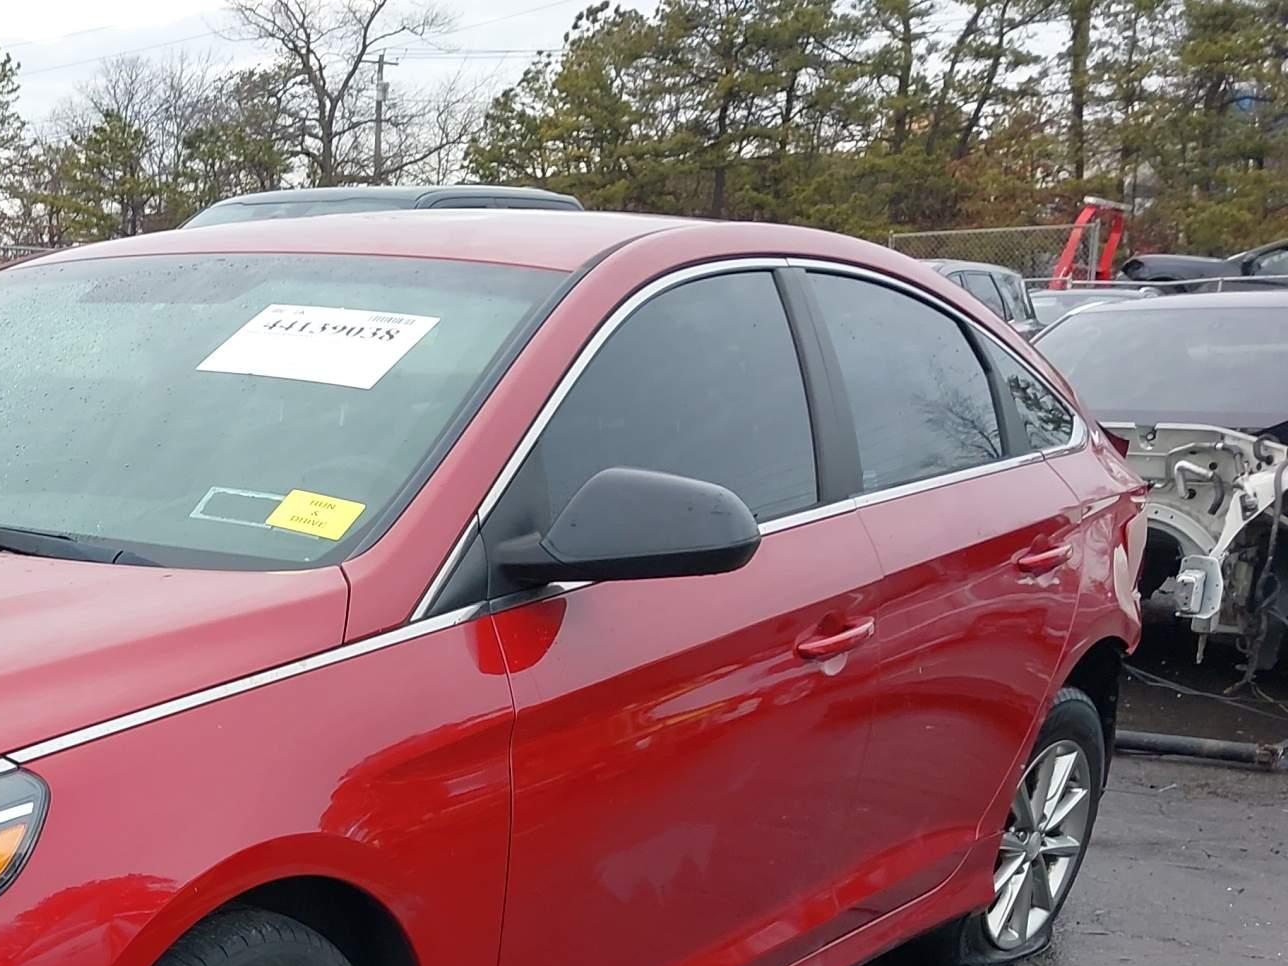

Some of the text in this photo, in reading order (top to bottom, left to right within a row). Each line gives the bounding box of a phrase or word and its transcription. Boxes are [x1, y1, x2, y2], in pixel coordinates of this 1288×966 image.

[263, 319, 401, 342] 44139038
[309, 500, 336, 510] RUN
[290, 515, 328, 528] DRIVE
